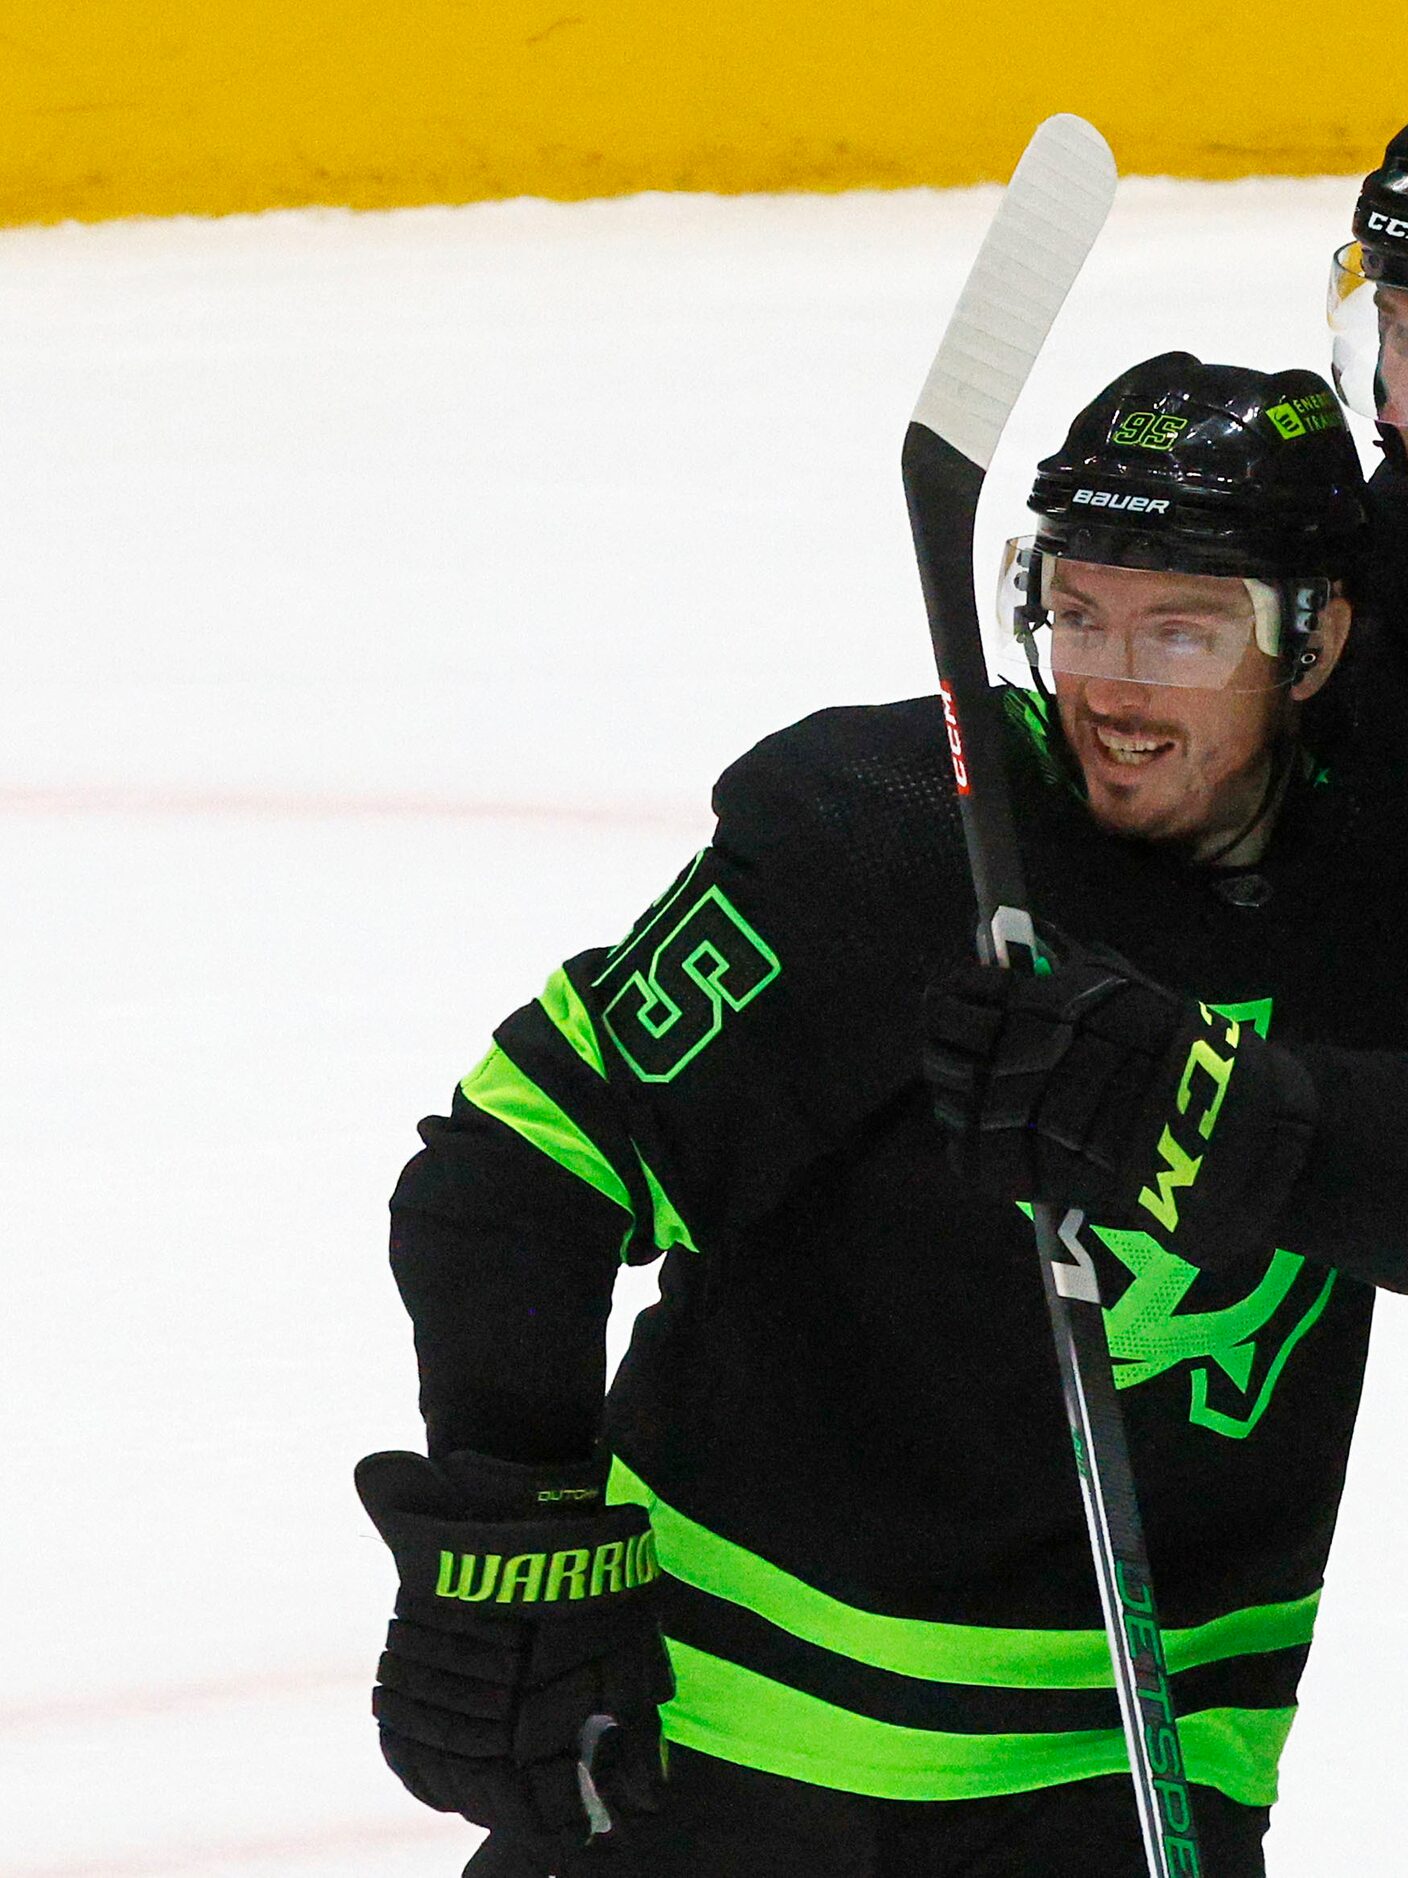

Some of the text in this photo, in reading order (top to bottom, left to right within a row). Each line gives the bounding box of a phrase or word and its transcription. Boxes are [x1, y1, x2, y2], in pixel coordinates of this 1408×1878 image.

[1113, 412, 1188, 451] 95
[1071, 488, 1171, 515] BAUER
[940, 688, 969, 789] CCM
